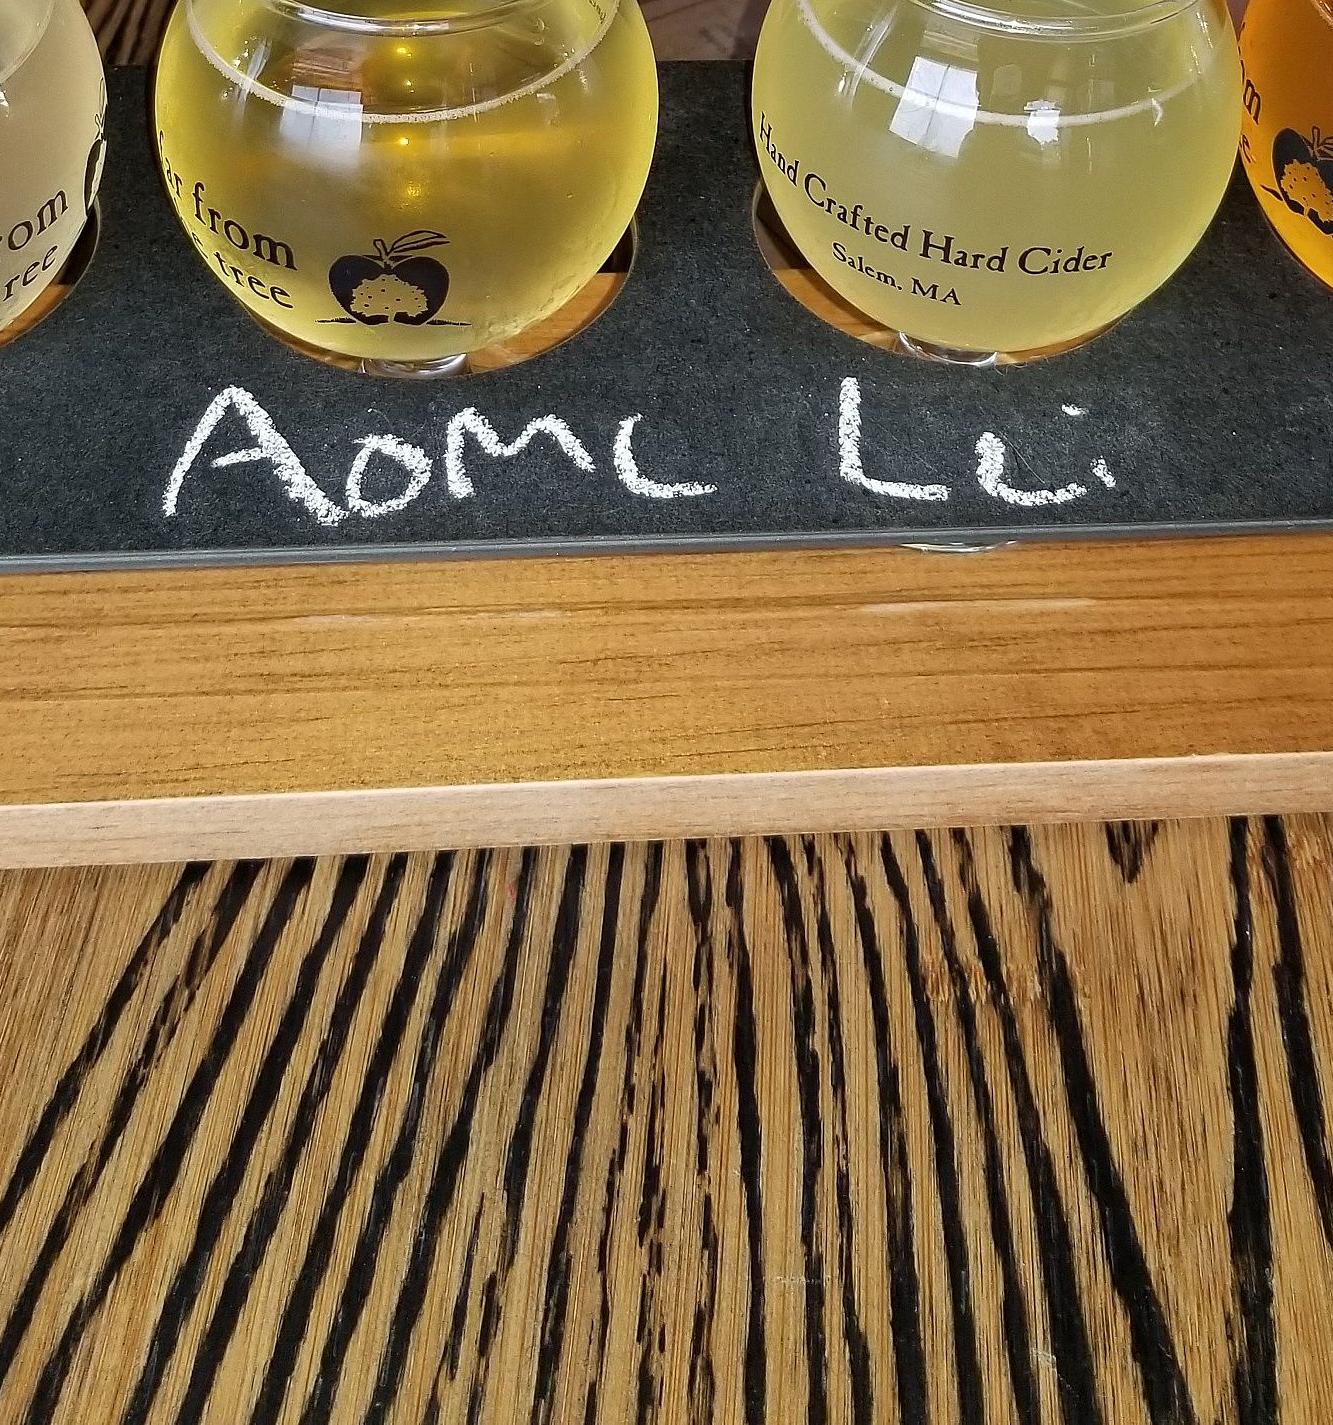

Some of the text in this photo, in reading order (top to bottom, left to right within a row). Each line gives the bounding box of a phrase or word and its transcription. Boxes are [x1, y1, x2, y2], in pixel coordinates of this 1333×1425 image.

[192, 181, 298, 271] from
[759, 110, 1113, 275] Hand Crafted Hard Cider
[213, 251, 294, 309] tree
[910, 277, 962, 306] MA
